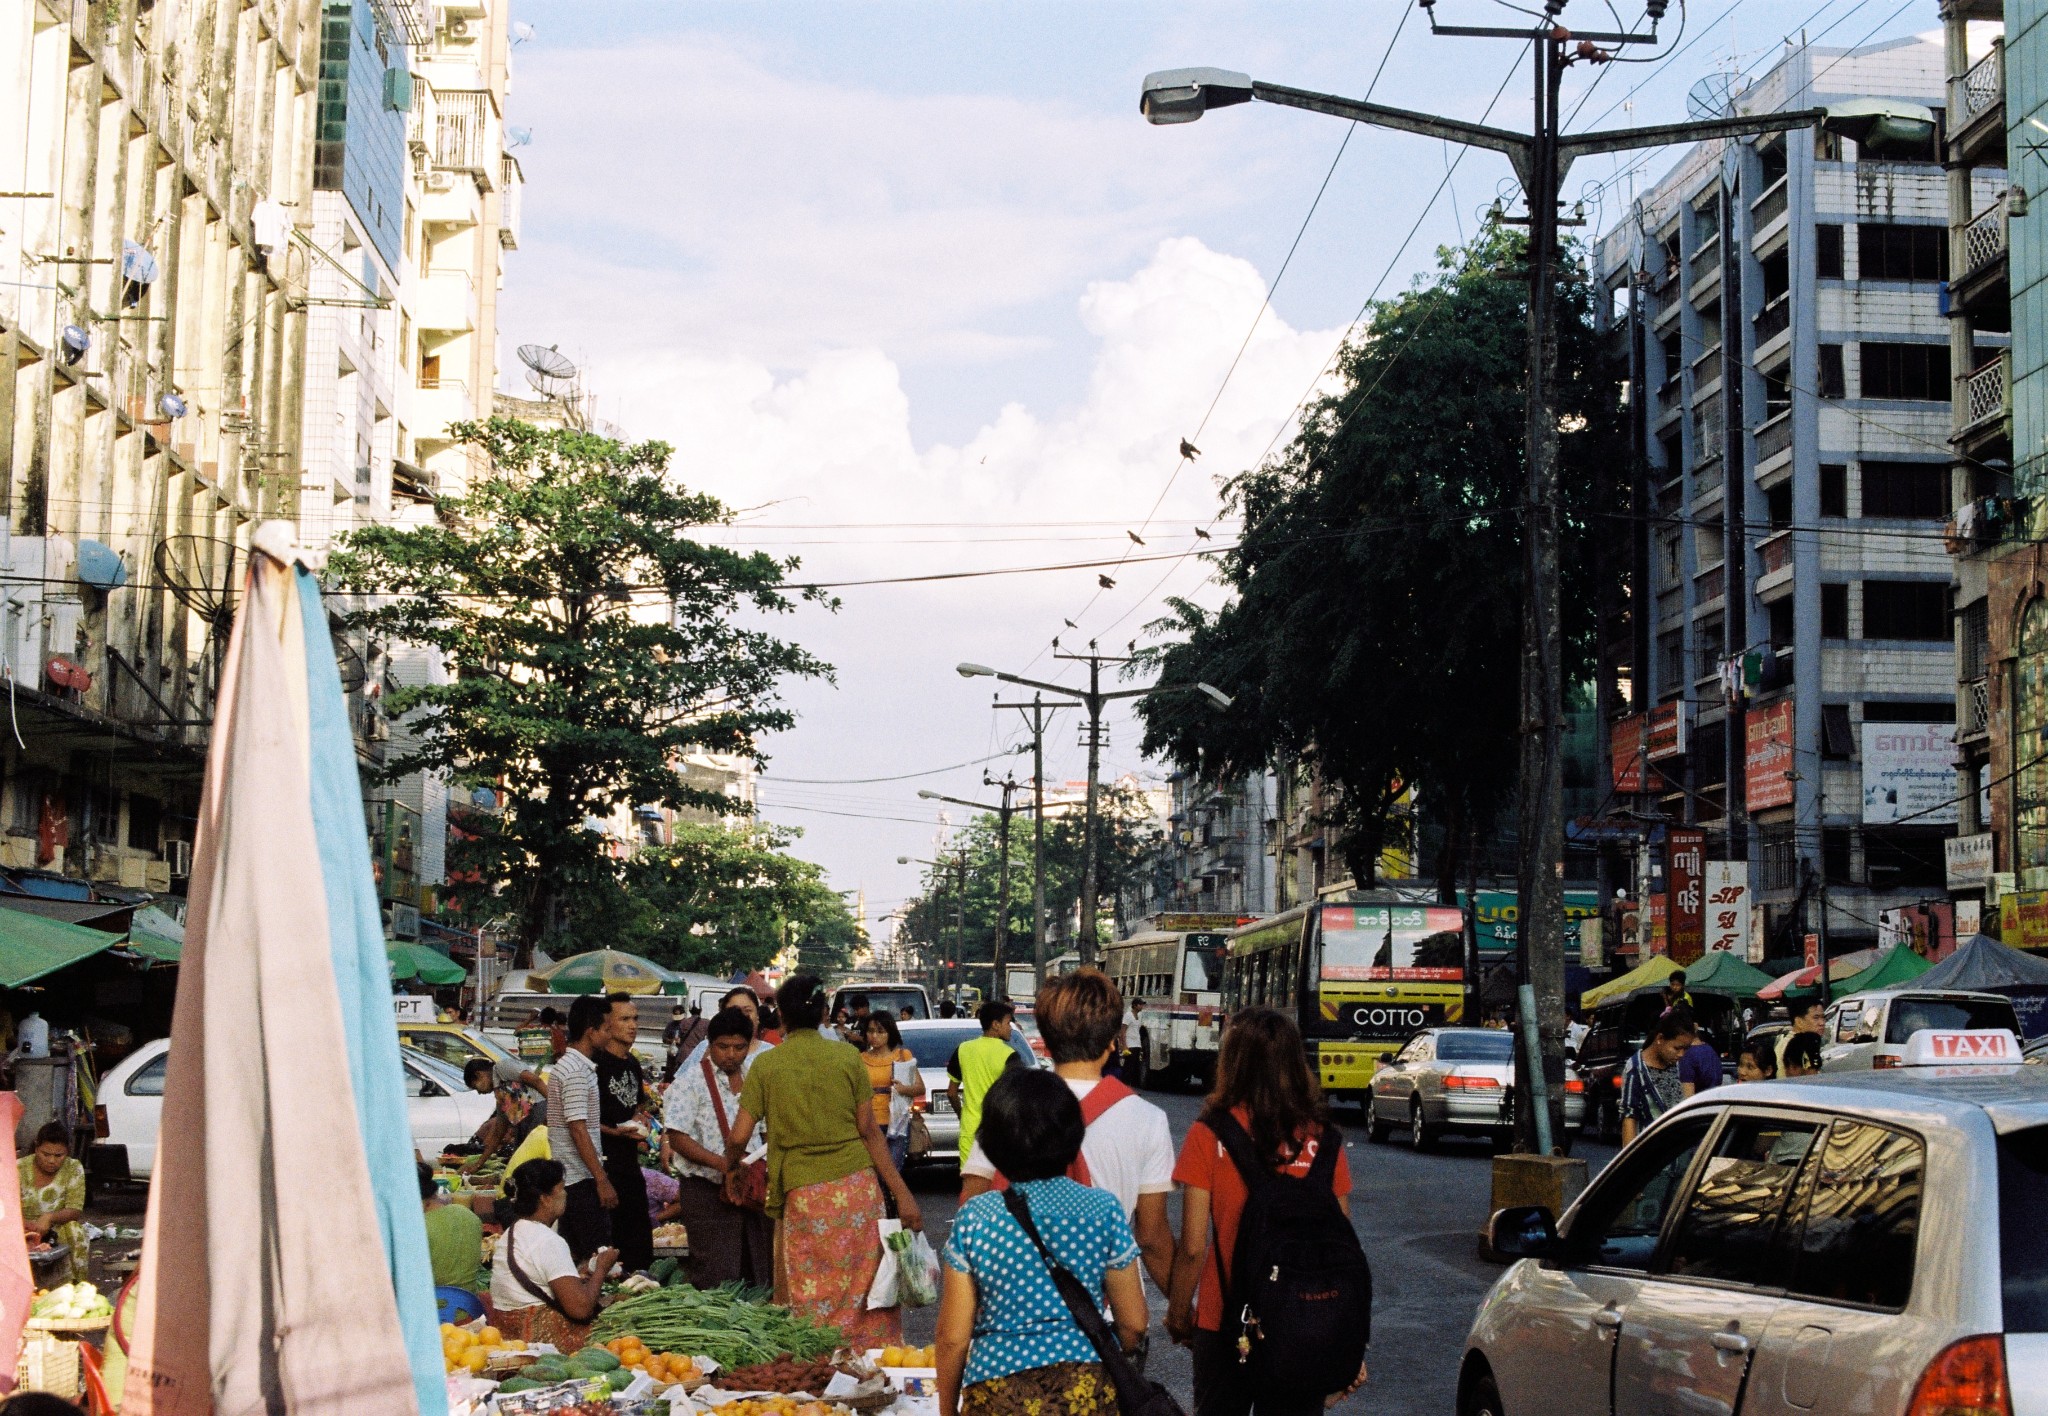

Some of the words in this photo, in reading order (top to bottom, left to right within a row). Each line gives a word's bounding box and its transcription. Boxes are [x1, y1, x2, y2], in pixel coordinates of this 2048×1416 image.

[1875, 725, 1958, 752] ကောင်း
[1353, 1008, 1424, 1026] COTTO
[1935, 1036, 2004, 1057] TAXI
